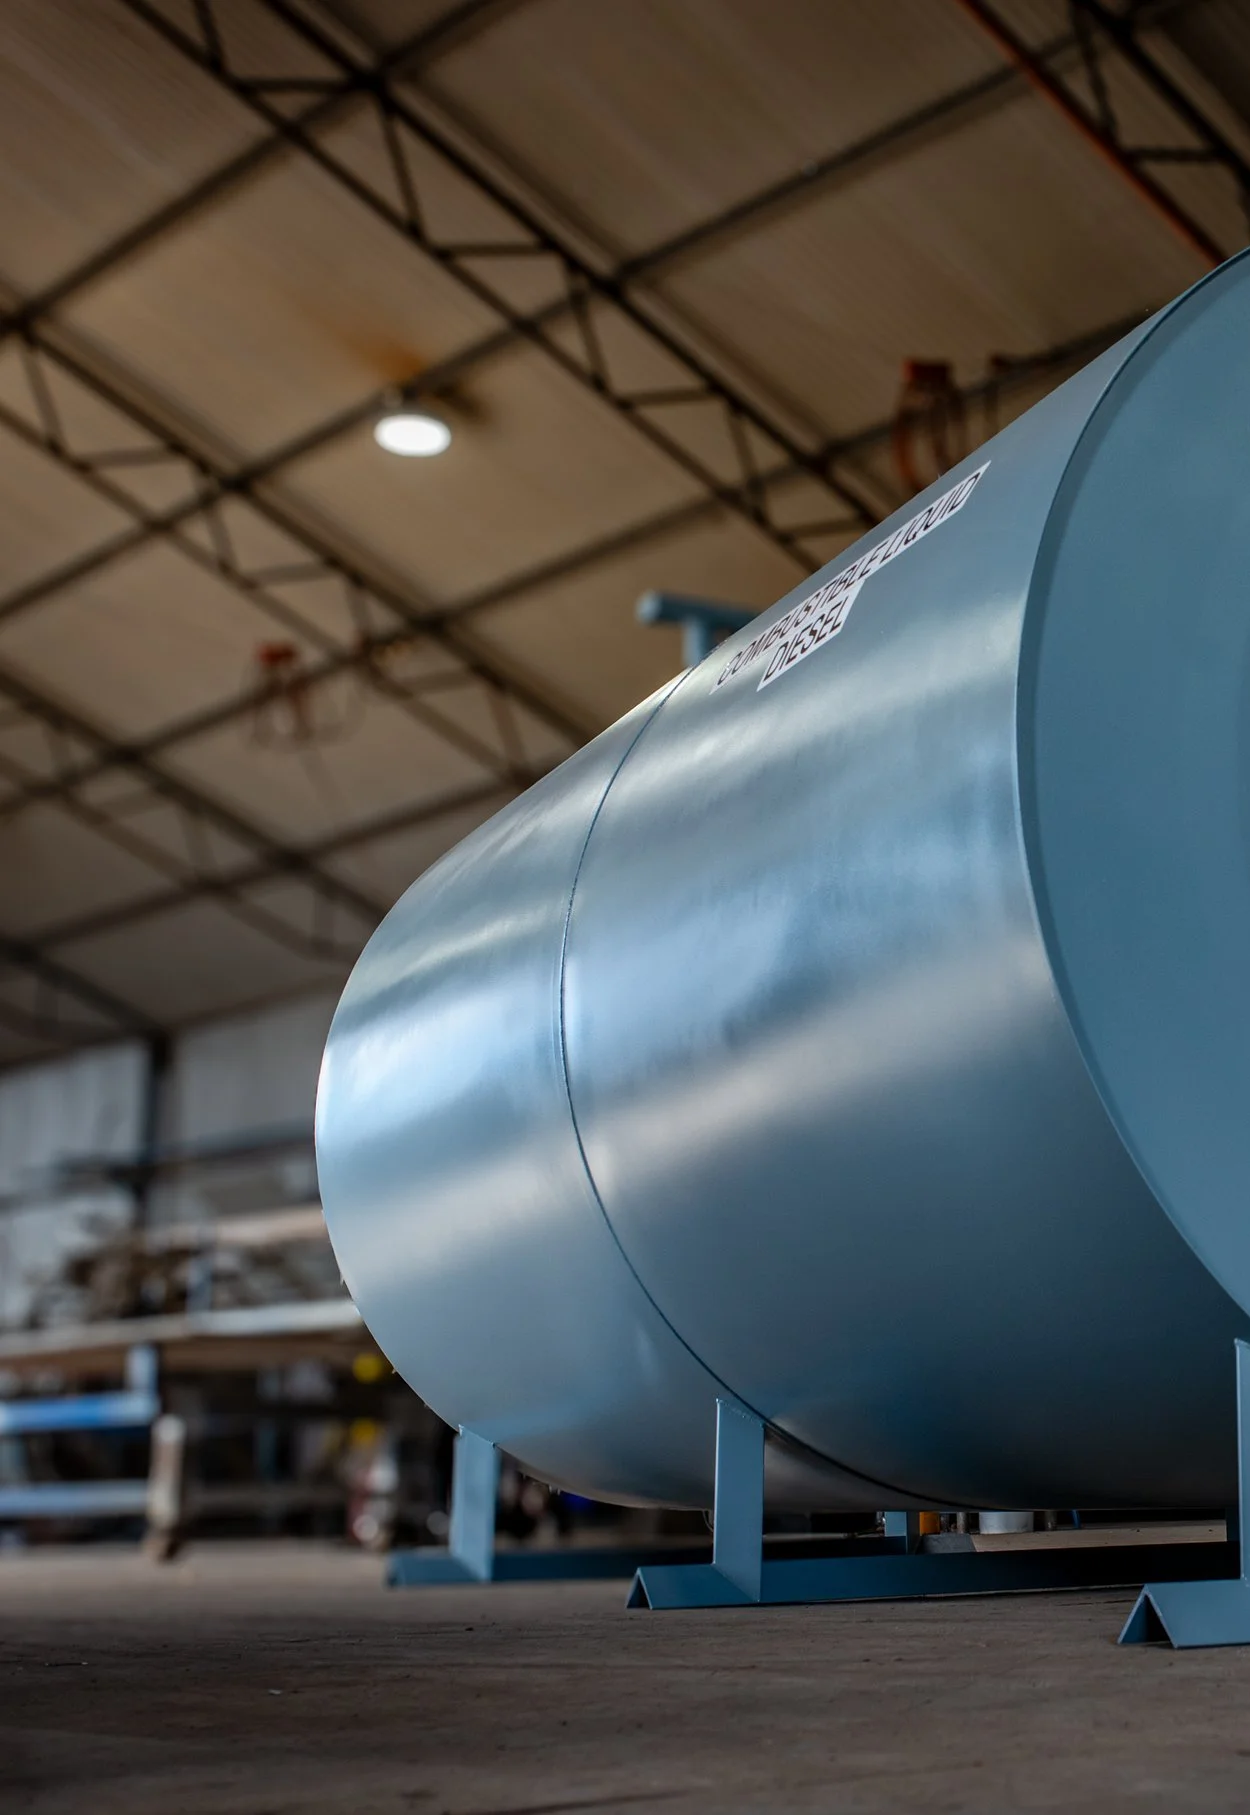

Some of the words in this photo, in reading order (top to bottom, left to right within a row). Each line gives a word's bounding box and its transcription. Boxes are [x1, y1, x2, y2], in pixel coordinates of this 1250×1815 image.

[717, 541, 888, 685] COMBUSTIBLE
[880, 472, 980, 563] LIQUID
[763, 595, 849, 682] DIESEL
